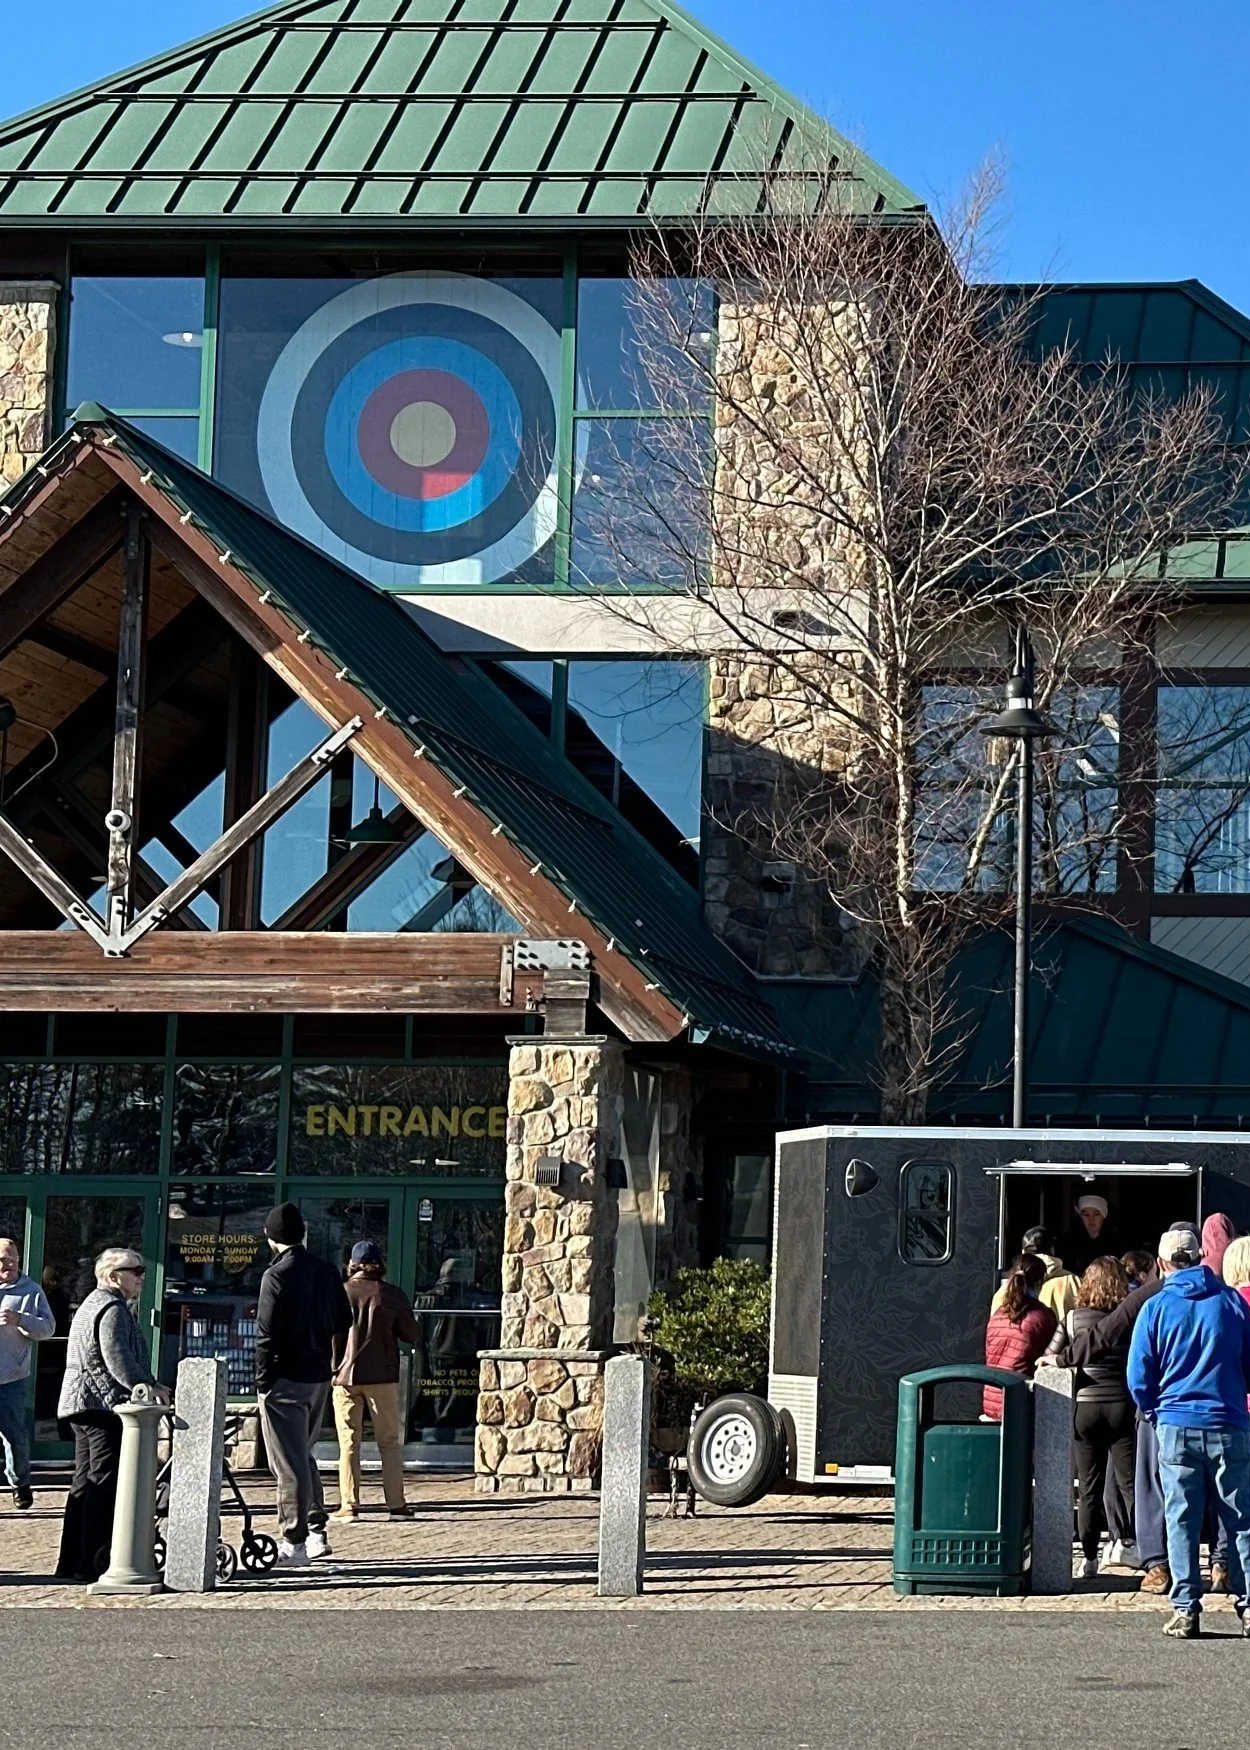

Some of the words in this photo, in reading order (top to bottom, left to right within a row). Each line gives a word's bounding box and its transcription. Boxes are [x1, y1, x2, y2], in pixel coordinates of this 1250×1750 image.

[306, 1104, 507, 1137] ENTRANCE
[181, 1234, 216, 1244] STORE
[218, 1234, 257, 1244] HOURS:
[180, 1246, 216, 1255] MONDAY
[223, 1246, 259, 1255] SUNDAY
[422, 1388, 449, 1397] SHIRTS
